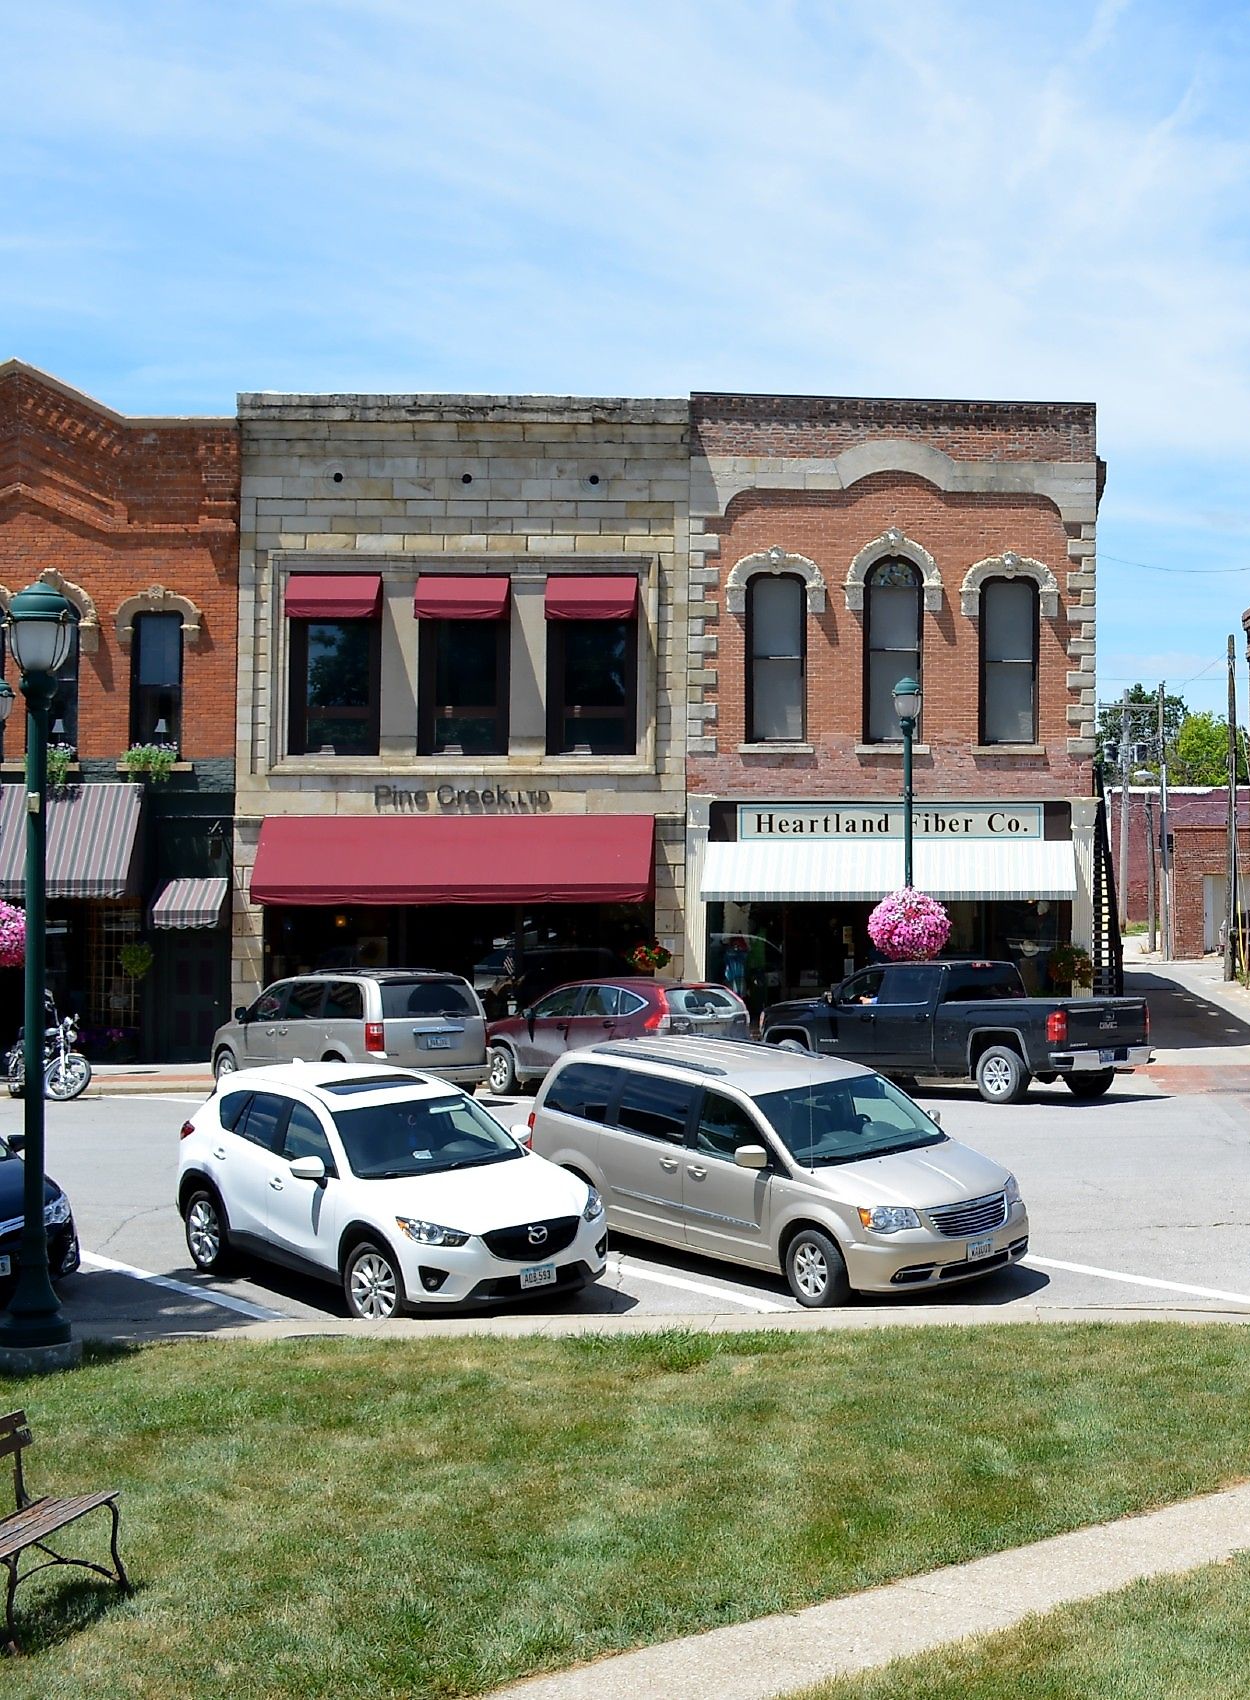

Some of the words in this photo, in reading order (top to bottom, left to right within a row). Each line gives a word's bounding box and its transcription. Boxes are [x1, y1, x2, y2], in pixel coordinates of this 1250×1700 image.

[374, 785, 428, 808] Pine
[755, 813, 890, 833] Heartland
[911, 812, 973, 833] Fiber
[987, 812, 1028, 833] Co.
